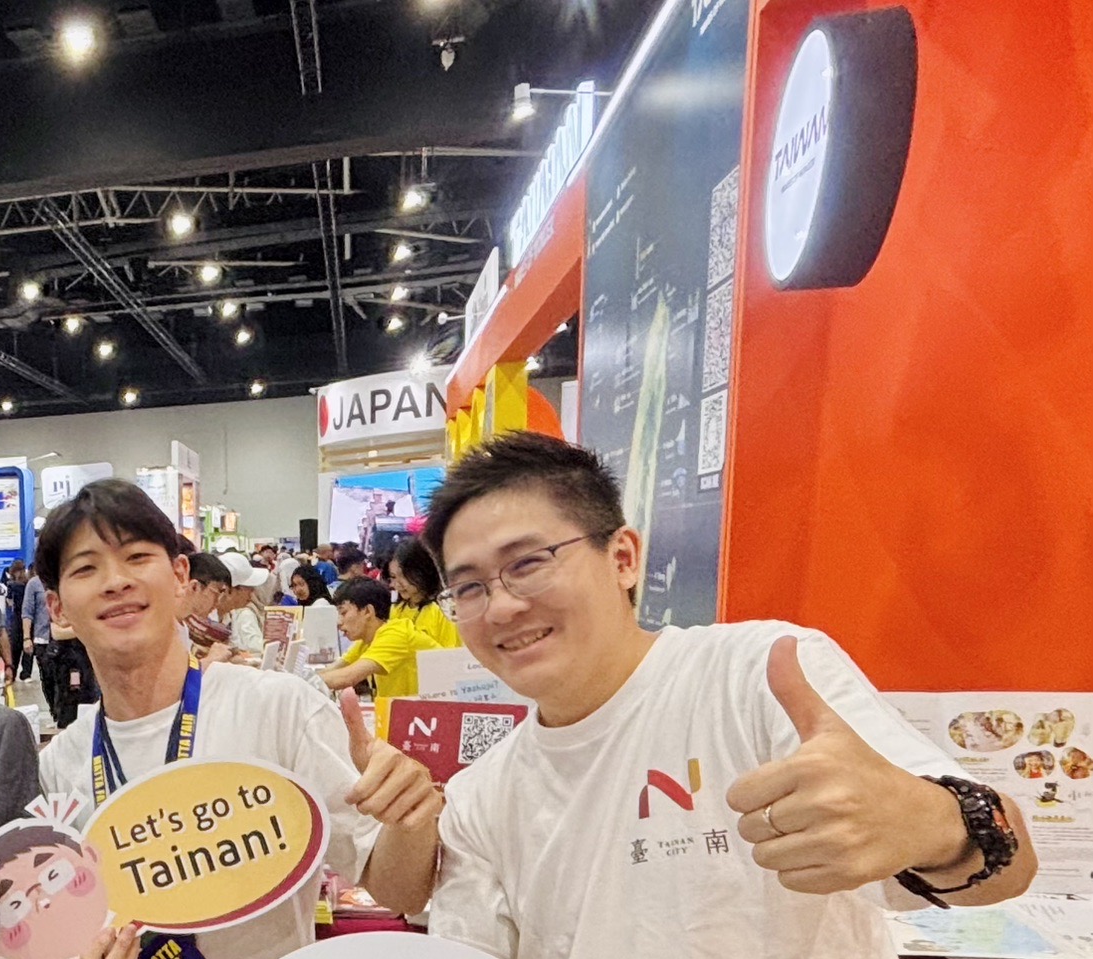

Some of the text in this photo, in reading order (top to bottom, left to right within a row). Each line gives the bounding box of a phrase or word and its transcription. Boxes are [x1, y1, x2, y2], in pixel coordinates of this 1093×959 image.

[332, 382, 447, 431] JAPAN
[109, 783, 272, 851] Let's go to
[120, 815, 288, 895] Tainan!
[658, 836, 695, 849] TAINAN
[666, 846, 688, 857] CITY
[703, 829, 729, 854] 南
